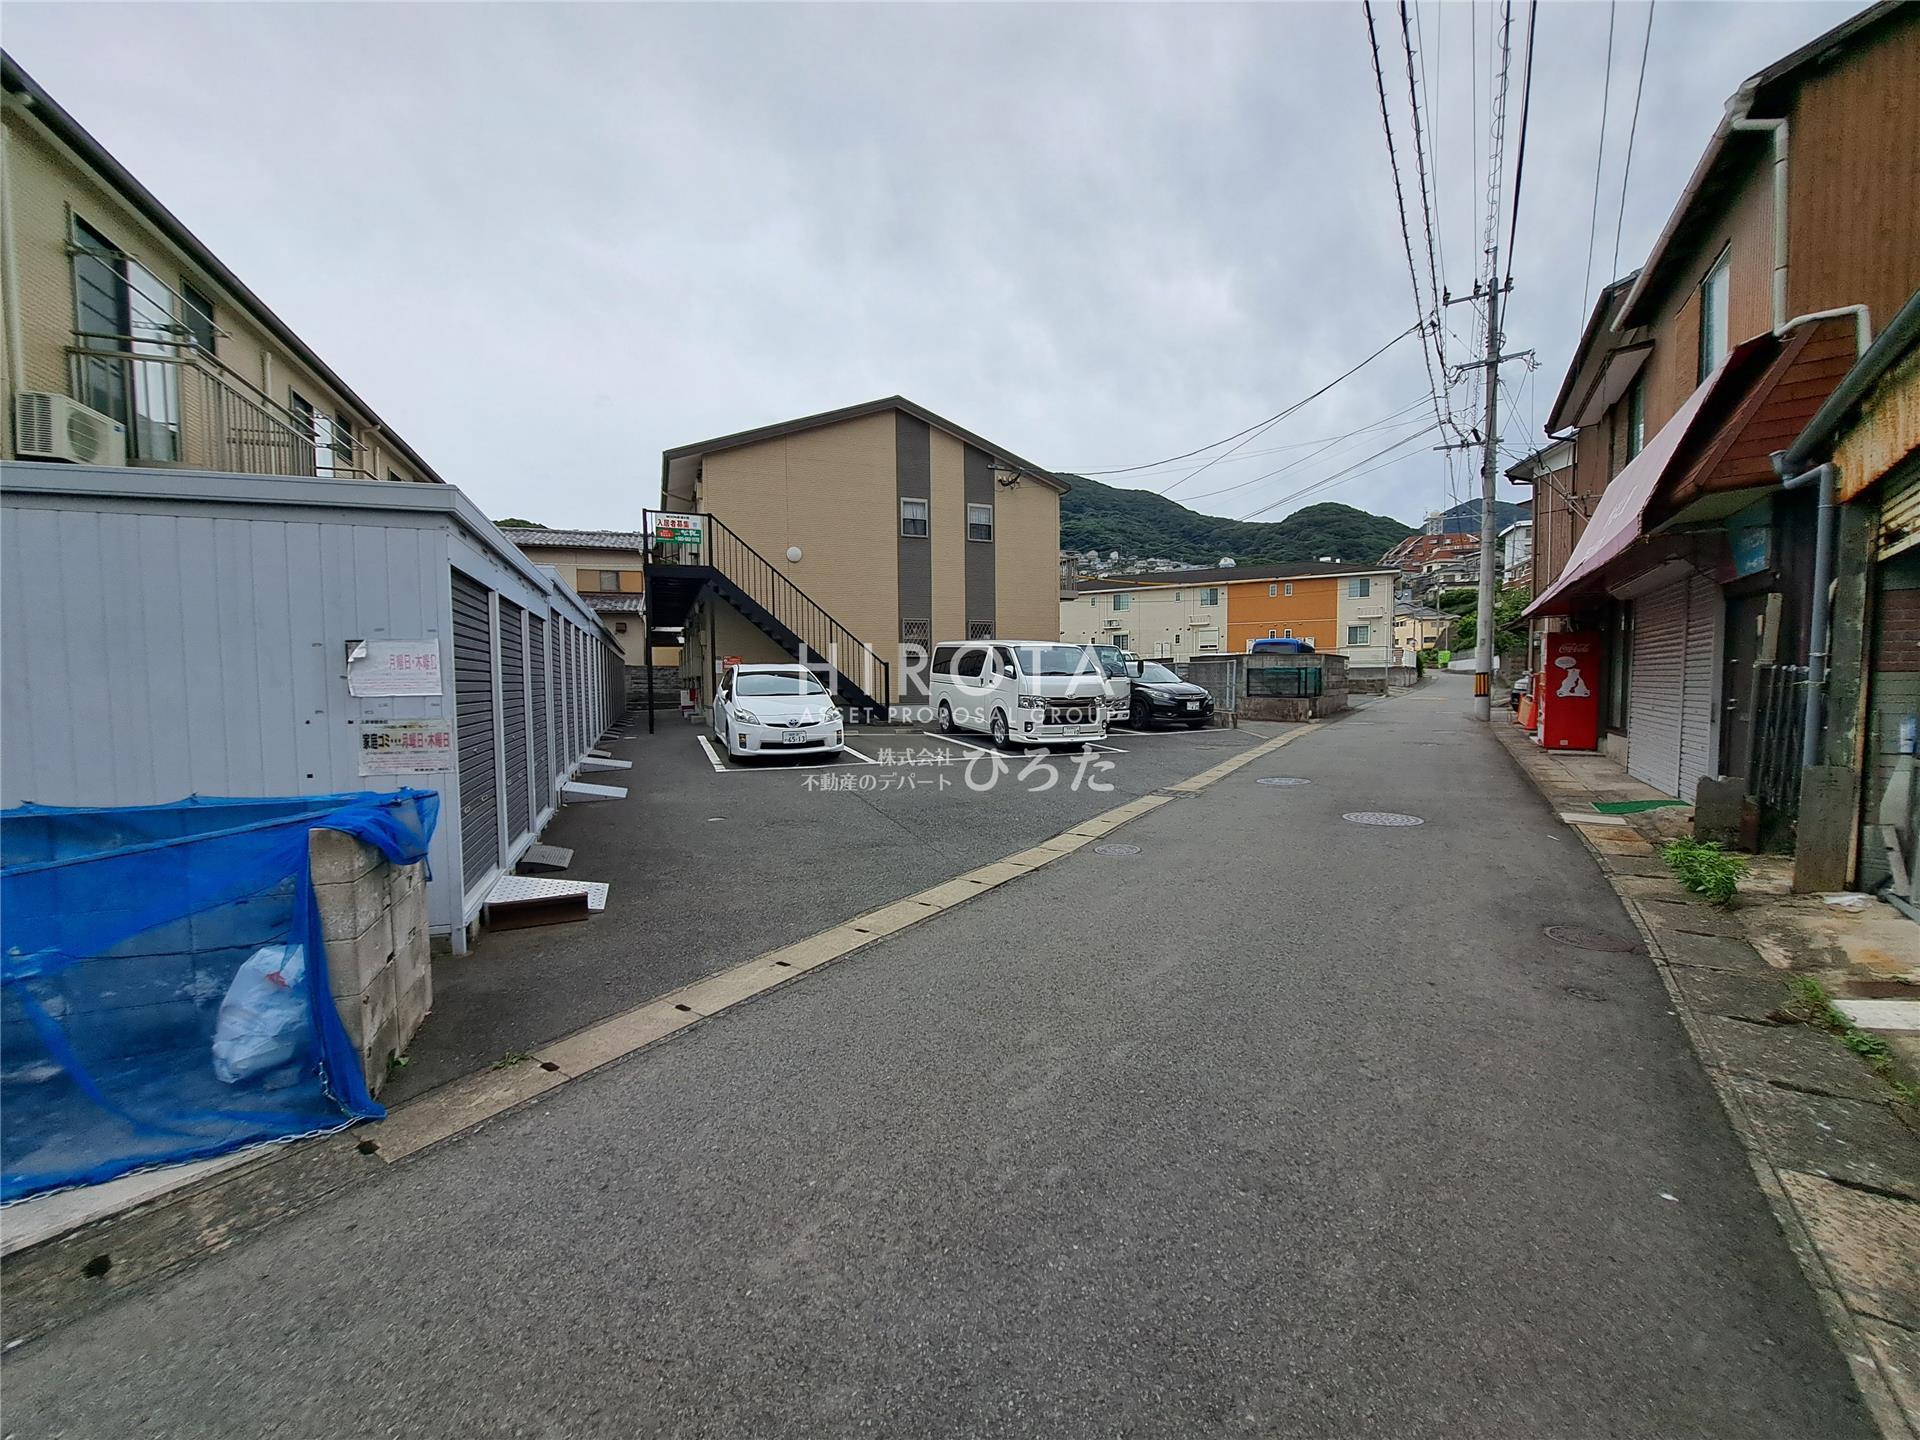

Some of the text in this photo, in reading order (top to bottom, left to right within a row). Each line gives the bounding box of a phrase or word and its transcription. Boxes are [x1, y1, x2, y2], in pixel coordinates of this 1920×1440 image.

[657, 519, 690, 528] 入居者募集
